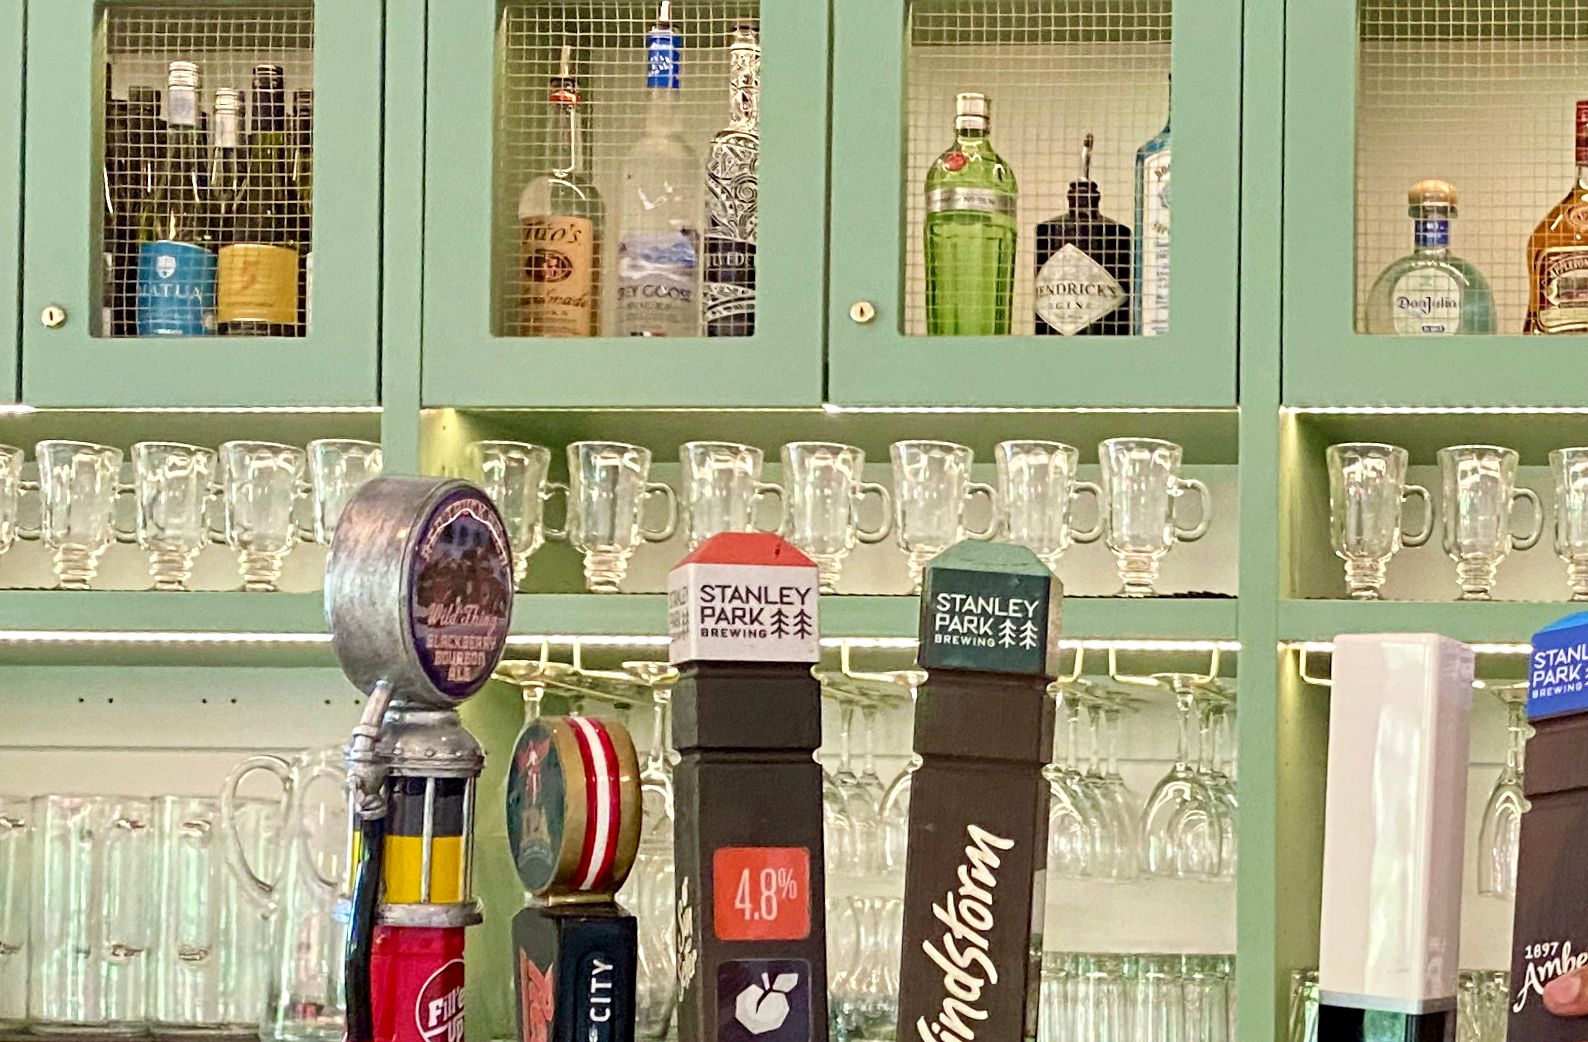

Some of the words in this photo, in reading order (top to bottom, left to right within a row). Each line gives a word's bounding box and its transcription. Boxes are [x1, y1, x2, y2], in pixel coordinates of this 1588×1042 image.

[700, 584, 812, 606] STANLEY
[936, 593, 1040, 618] STANLEY
[700, 606, 765, 626] PARK
[935, 613, 995, 636] PARK
[700, 627, 768, 639] BREWING
[934, 634, 996, 648] BREWING
[1532, 662, 1583, 688] PARK
[1531, 681, 1583, 699] BREWING
[734, 867, 797, 921] 4.8%
[1524, 941, 1559, 959] 1897
[589, 959, 614, 1023] CITY
